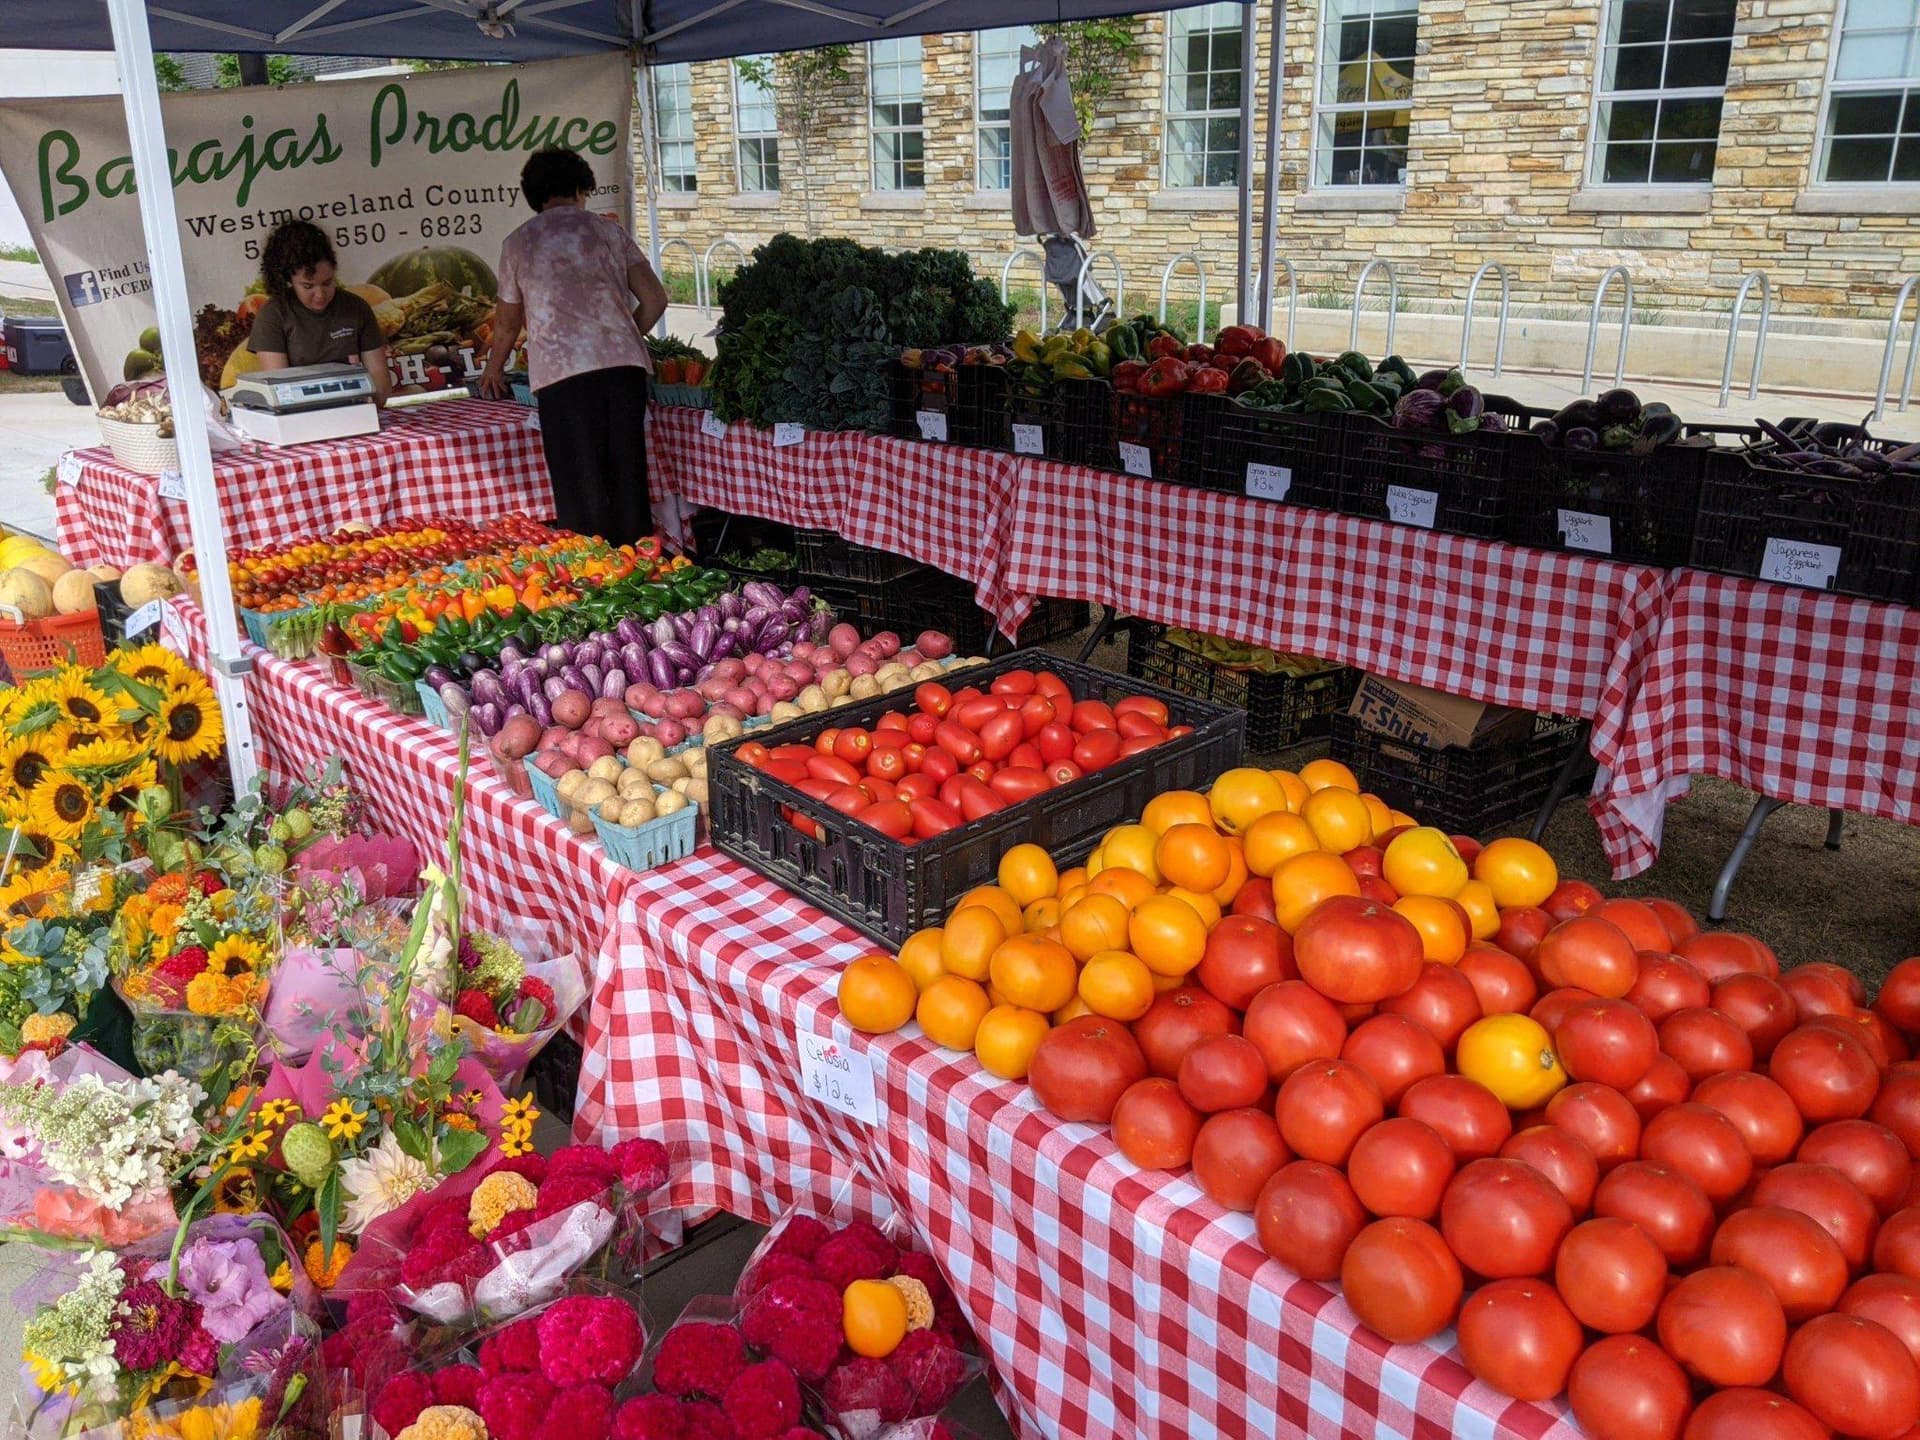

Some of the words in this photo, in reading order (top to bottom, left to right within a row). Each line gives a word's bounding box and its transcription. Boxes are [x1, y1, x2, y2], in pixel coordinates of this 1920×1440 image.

[371, 78, 617, 167] Produce
[185, 188, 415, 238] Westmoreland
[426, 184, 520, 207] County
[336, 222, 386, 248] 550
[420, 214, 482, 238] 6823
[98, 264, 131, 282] Find
[135, 260, 150, 275] Us
[102, 279, 153, 301] FACEB
[1254, 475, 1267, 490] $3
[1566, 527, 1580, 542] $3
[1771, 539, 1820, 559] Japanese
[1774, 565, 1792, 580] $3
[1360, 693, 1430, 748] T-Shirt
[806, 1038, 851, 1073] Celosia
